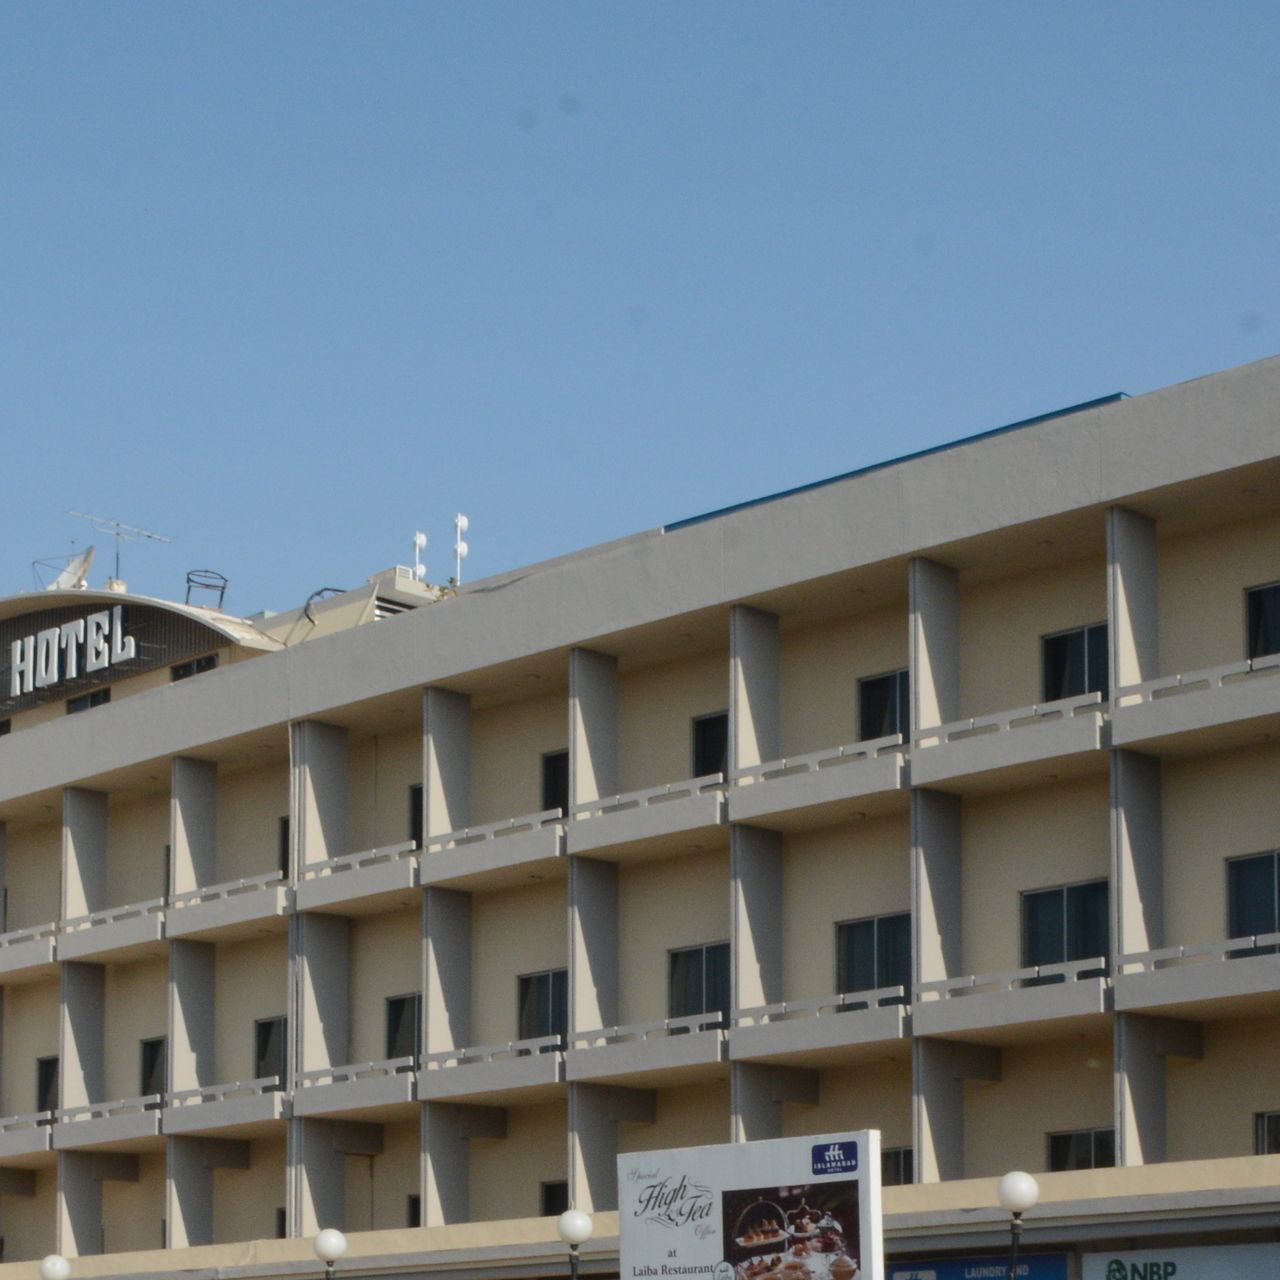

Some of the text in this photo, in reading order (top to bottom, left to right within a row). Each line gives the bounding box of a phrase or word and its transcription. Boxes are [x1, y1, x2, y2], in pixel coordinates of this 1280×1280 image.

[10, 605, 136, 697] HOTEL
[814, 1160, 856, 1169] ISLAMABAD
[634, 1174, 688, 1222] High
[675, 1194, 713, 1227] Tea
[667, 1249, 677, 1258] at
[633, 1265, 714, 1277] Laiba Restaurant
[964, 1265, 1007, 1279] LAUNDRY
